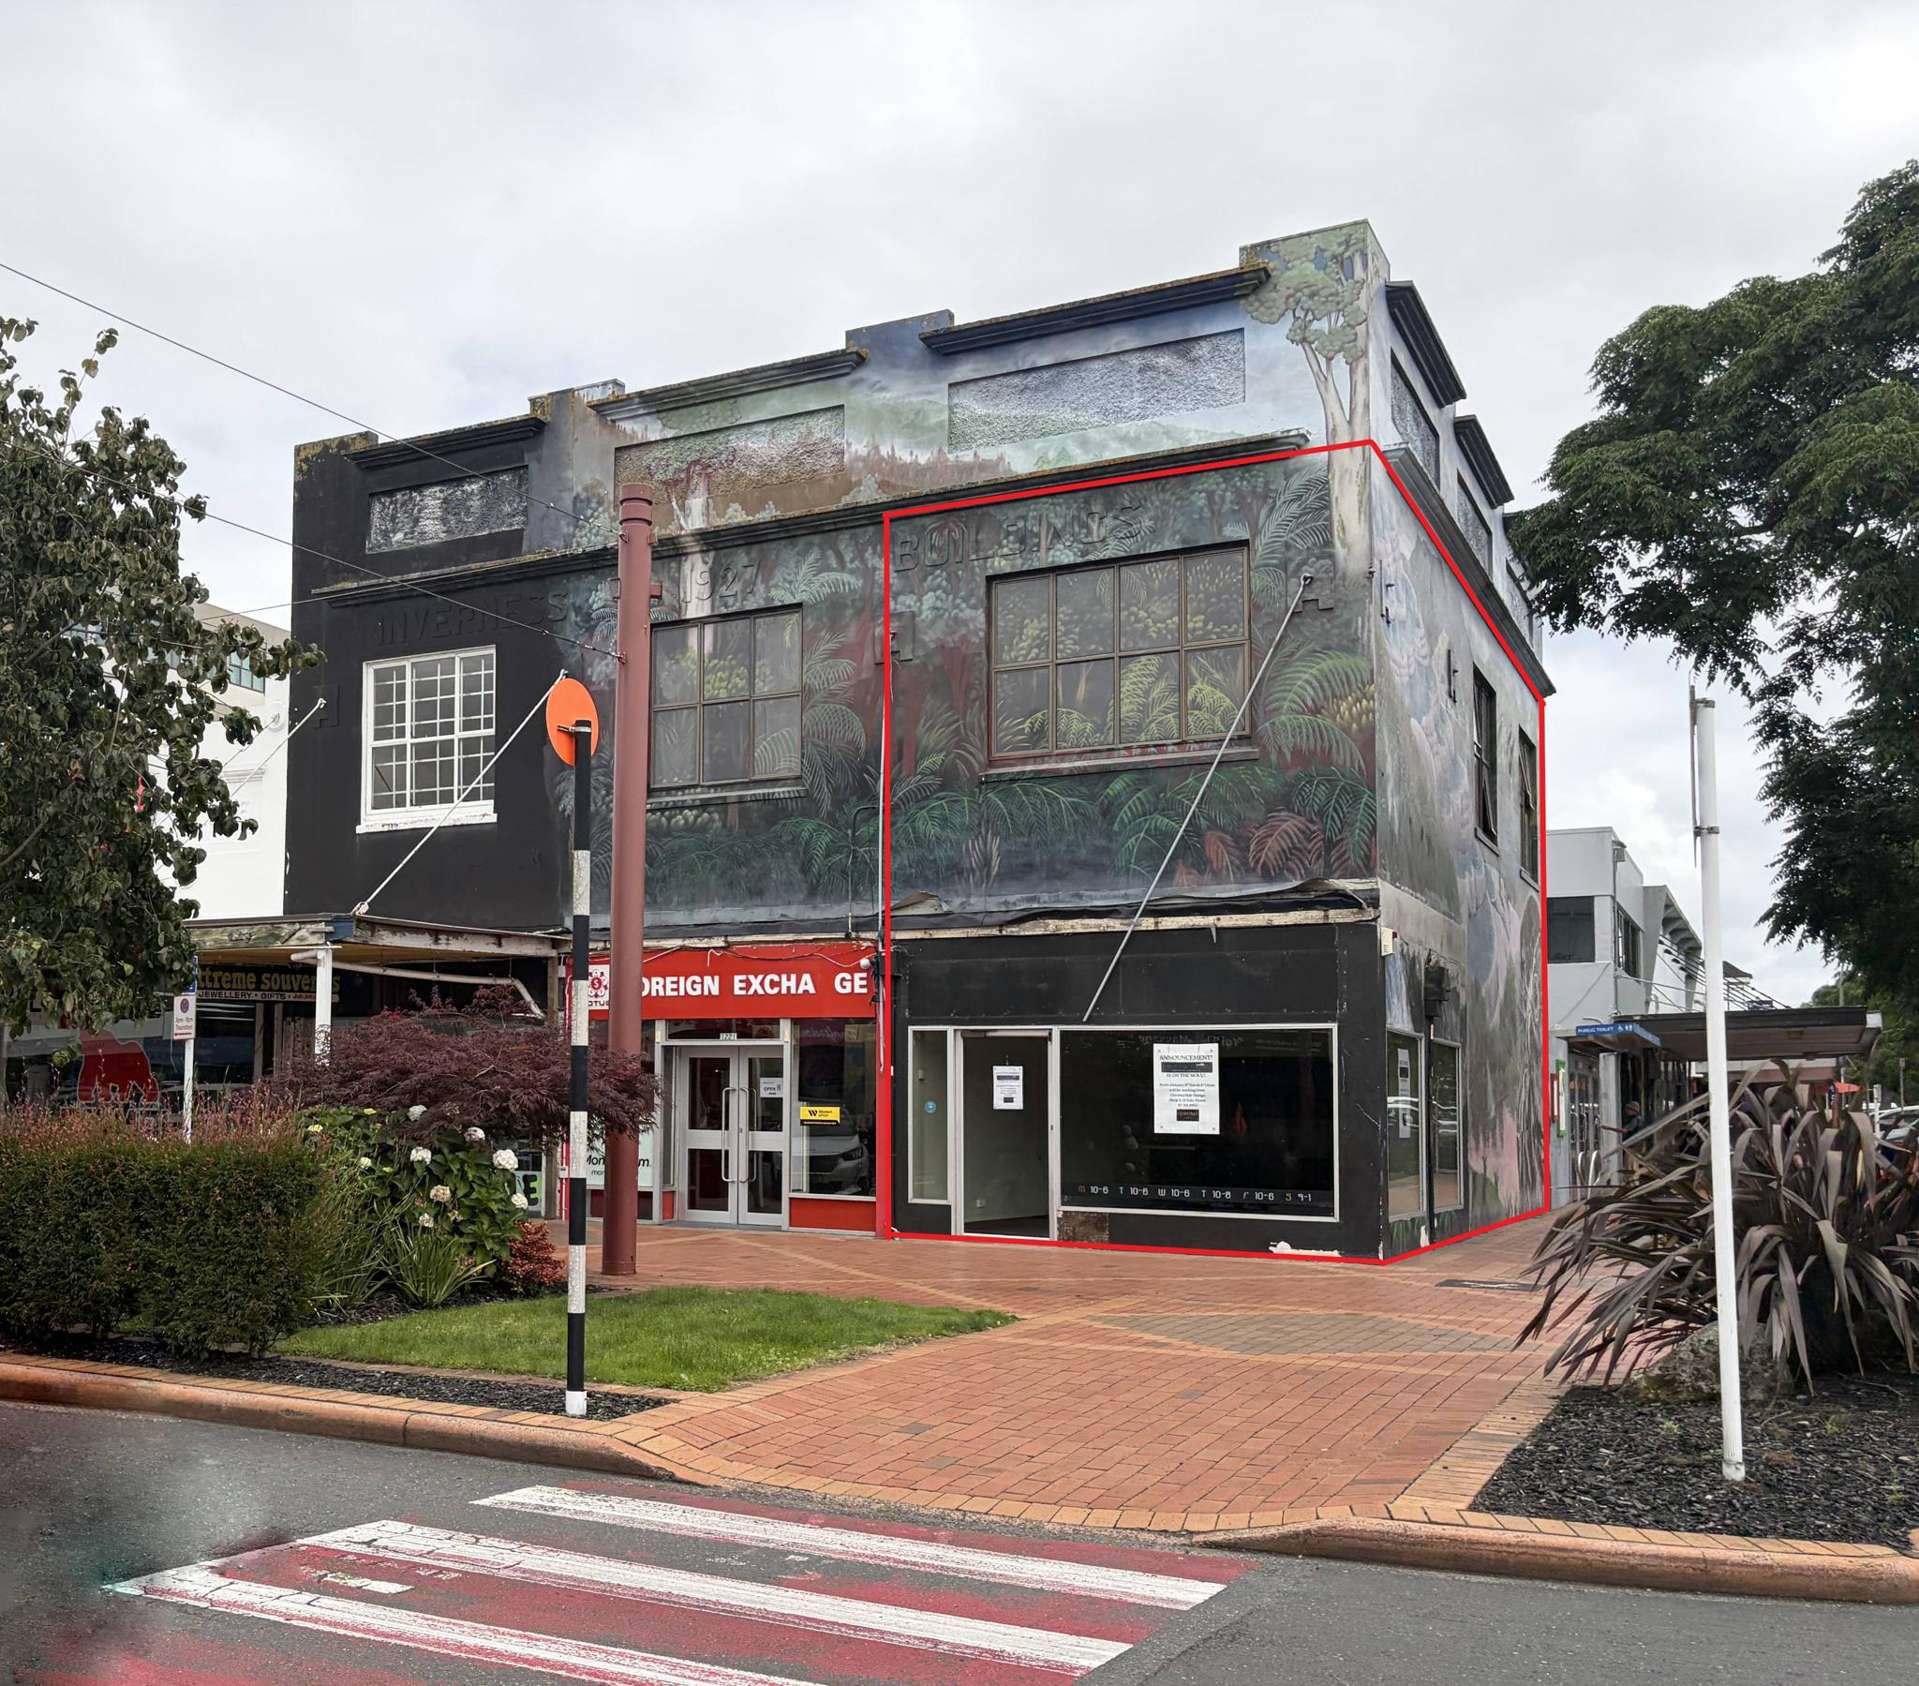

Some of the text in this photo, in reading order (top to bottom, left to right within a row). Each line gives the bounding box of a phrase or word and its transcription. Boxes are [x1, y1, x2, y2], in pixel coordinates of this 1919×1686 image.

[893, 503, 1144, 572] BUILDINGS
[681, 559, 762, 604] 1927
[641, 975, 720, 998] OREIGN
